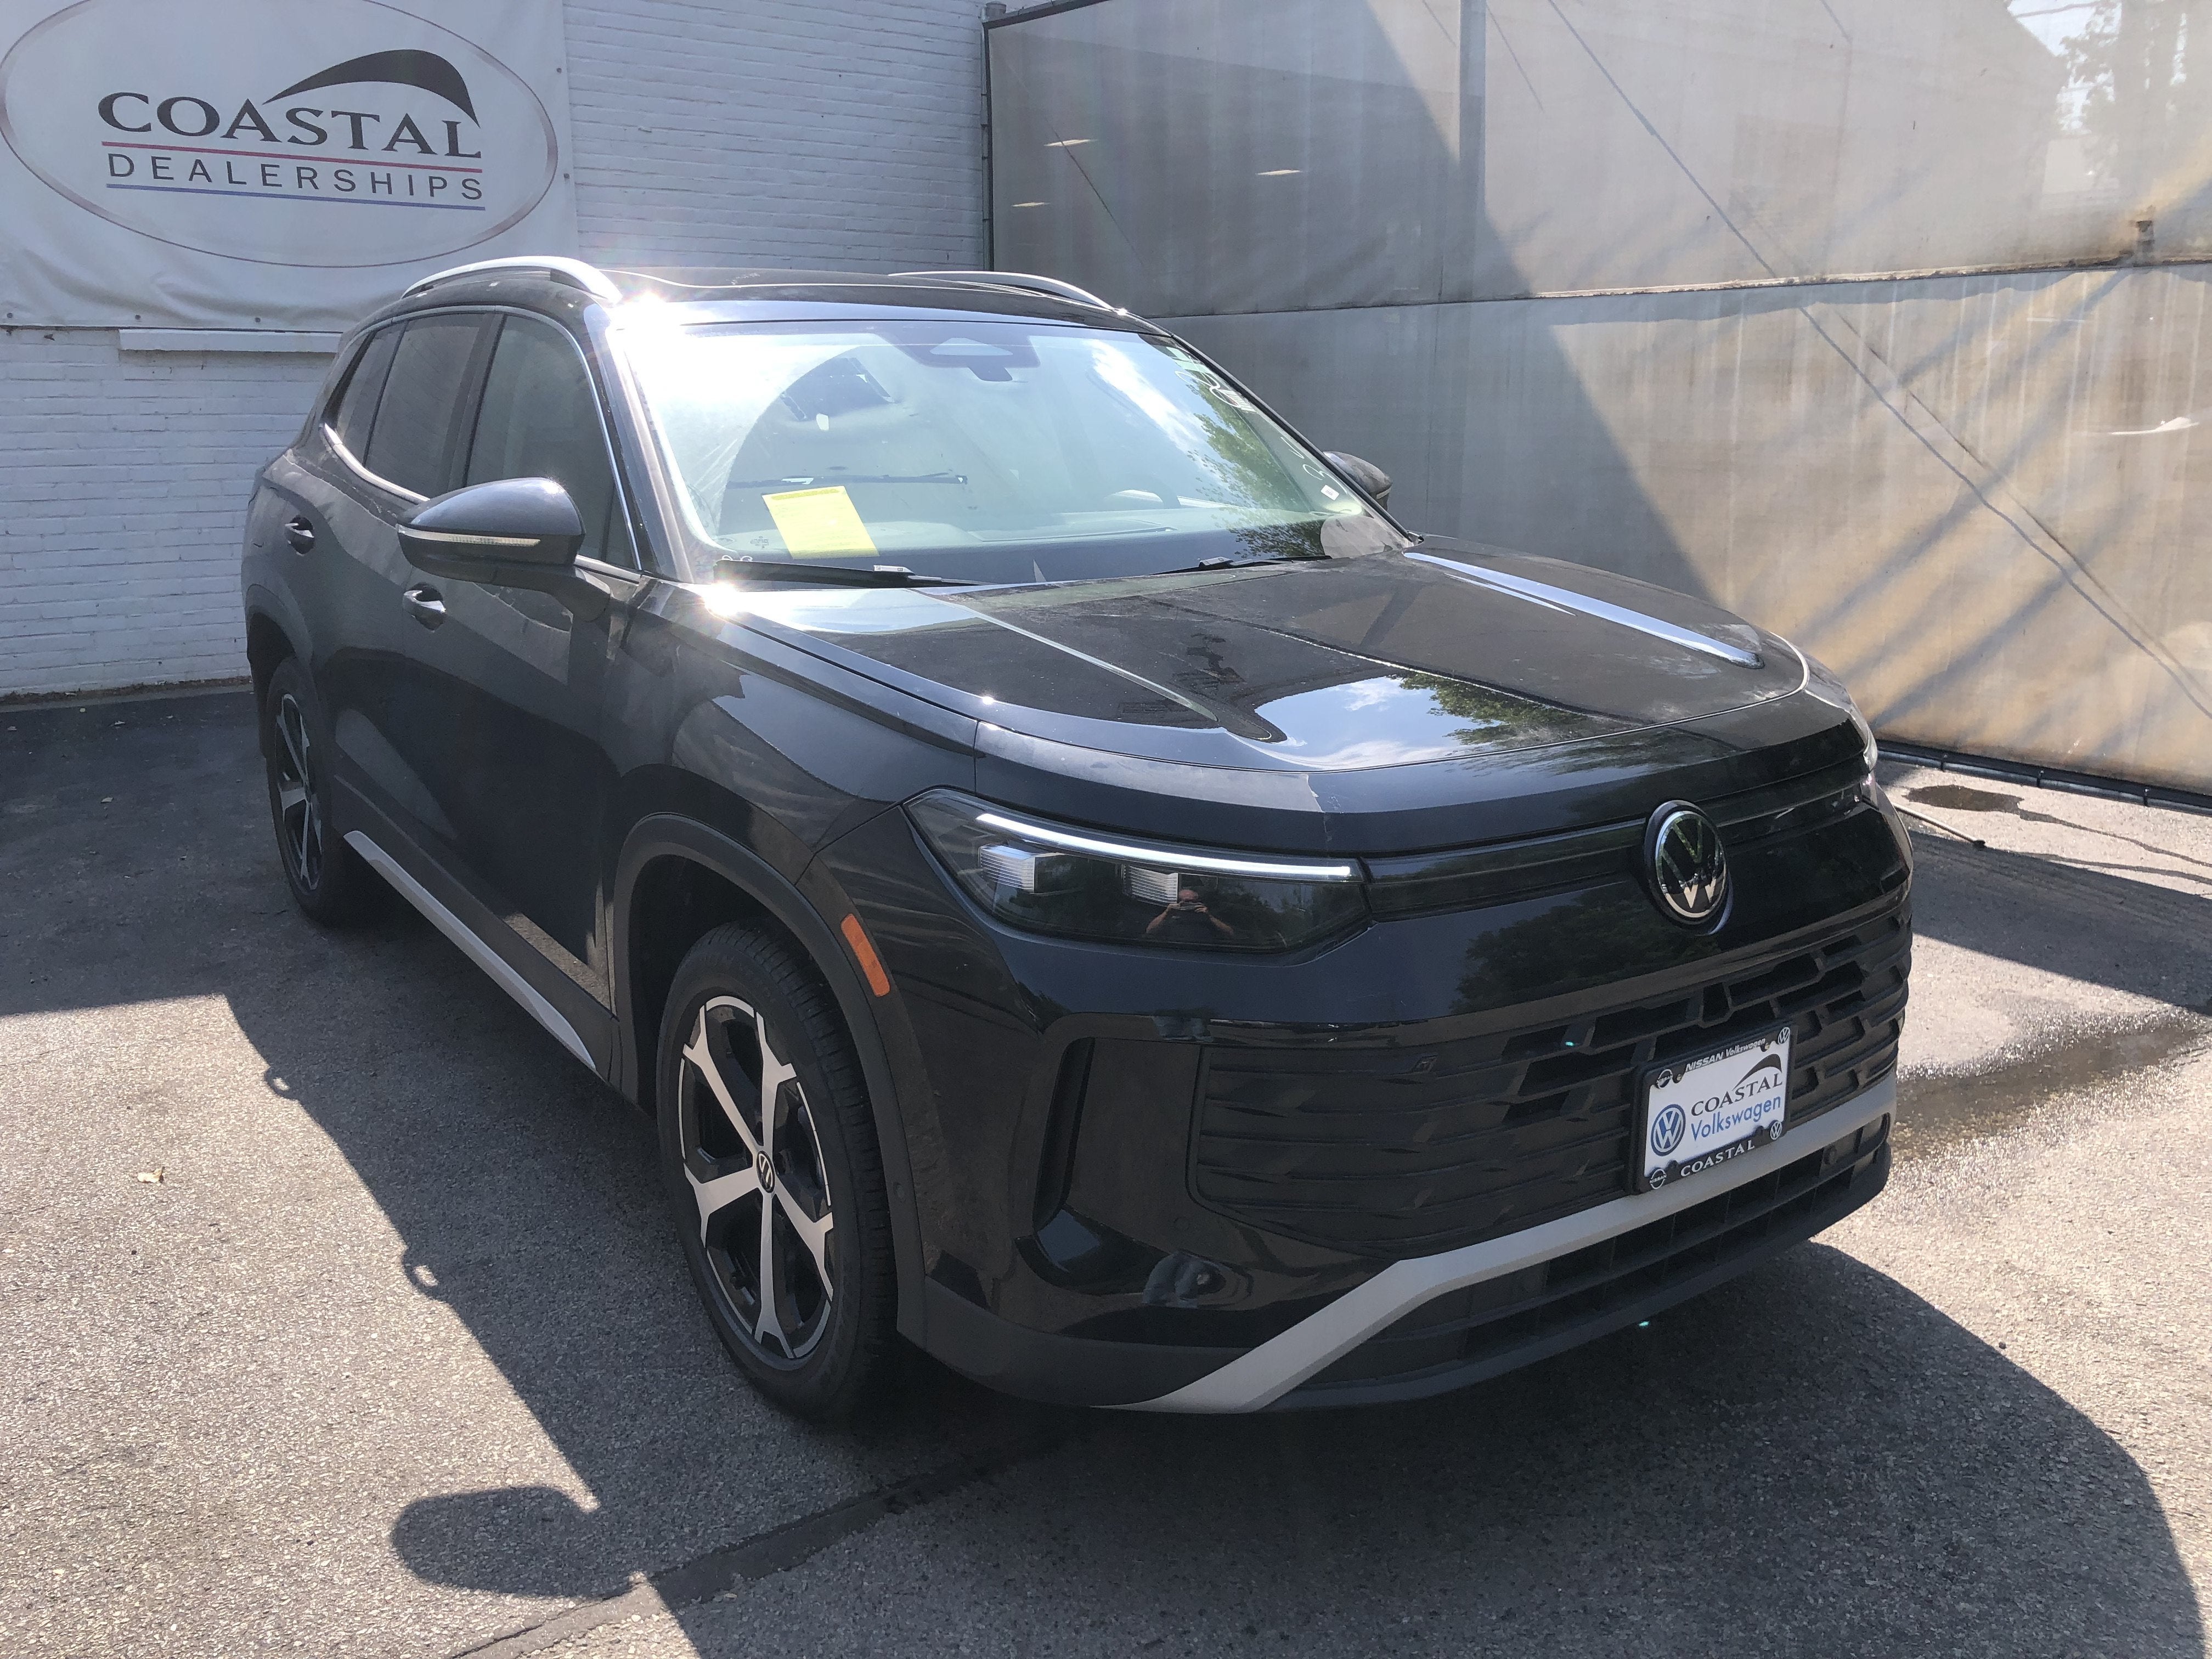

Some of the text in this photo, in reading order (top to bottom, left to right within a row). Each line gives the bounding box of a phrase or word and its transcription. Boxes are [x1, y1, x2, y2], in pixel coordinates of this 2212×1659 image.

[98, 92, 481, 158] COASTAL
[108, 153, 483, 200] DEALERSHIPS
[1685, 1038, 1765, 1071] NISSAN Volkswagen
[1691, 1074, 1782, 1116] COASTAL
[1652, 1105, 1684, 1155] VW
[1691, 1096, 1781, 1141] Volkswagen
[1650, 1174, 1667, 1183] NISSAN
[1680, 1140, 1754, 1177] COASTAL
